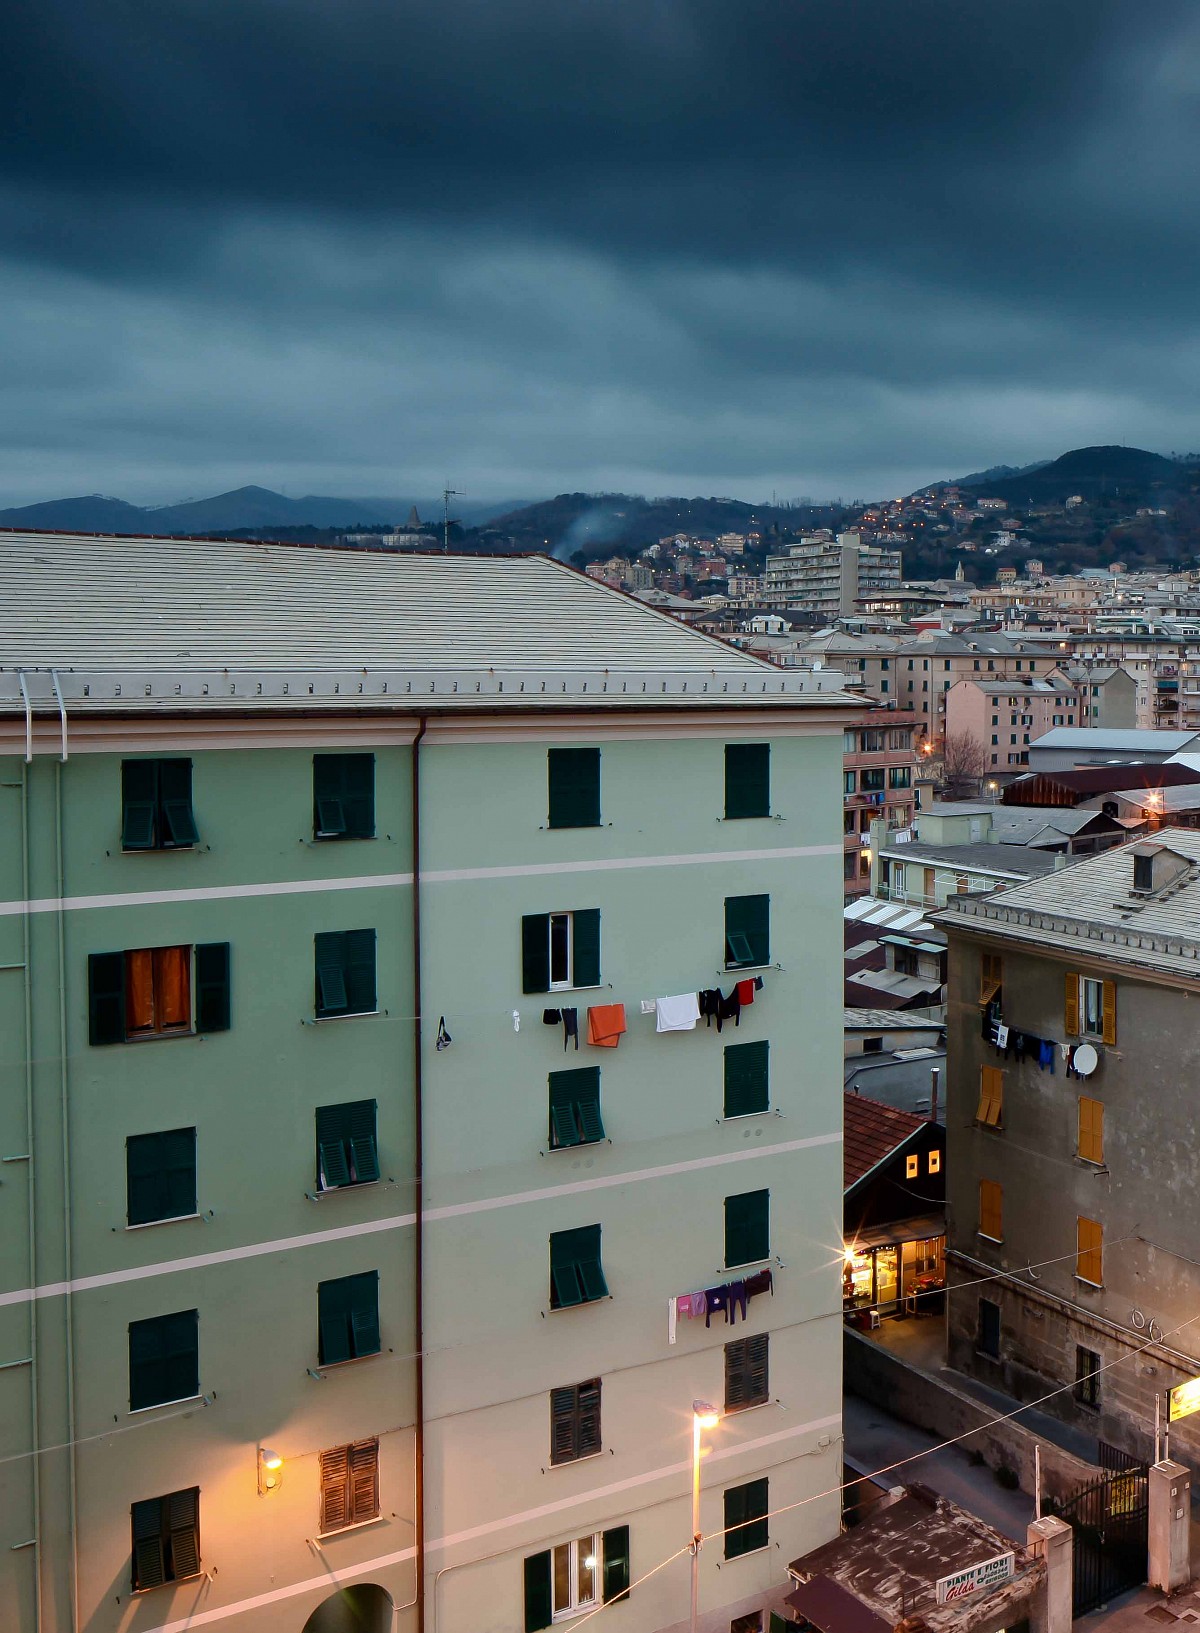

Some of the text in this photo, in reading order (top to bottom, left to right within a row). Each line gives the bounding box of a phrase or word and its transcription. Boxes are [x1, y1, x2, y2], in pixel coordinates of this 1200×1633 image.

[947, 1571, 974, 1587] PIANTE
[985, 1559, 1008, 1573] FIORI
[946, 1581, 974, 1600] Gilda
